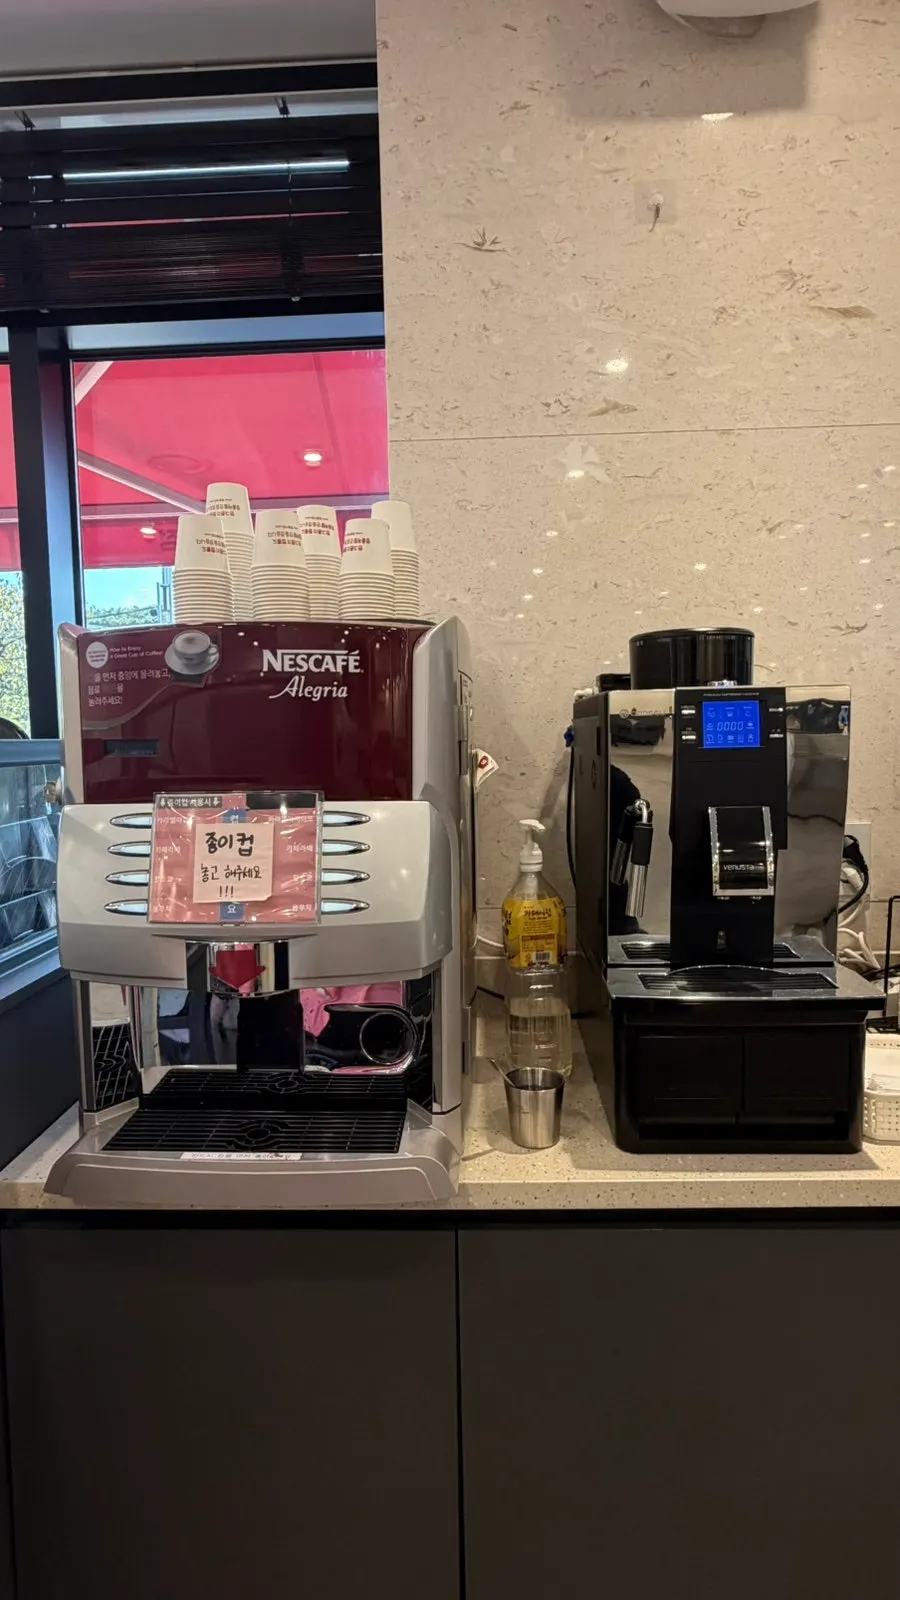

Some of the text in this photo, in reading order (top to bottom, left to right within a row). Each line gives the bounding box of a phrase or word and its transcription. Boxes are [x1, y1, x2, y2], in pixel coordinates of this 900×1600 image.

[262, 649, 361, 674] NESCAFÉ
[268, 675, 348, 701] Alegria
[205, 831, 254, 856] 종이컵
[200, 863, 220, 883] 놓고
[223, 864, 262, 881] 해주세요
[219, 885, 234, 898] !!!
